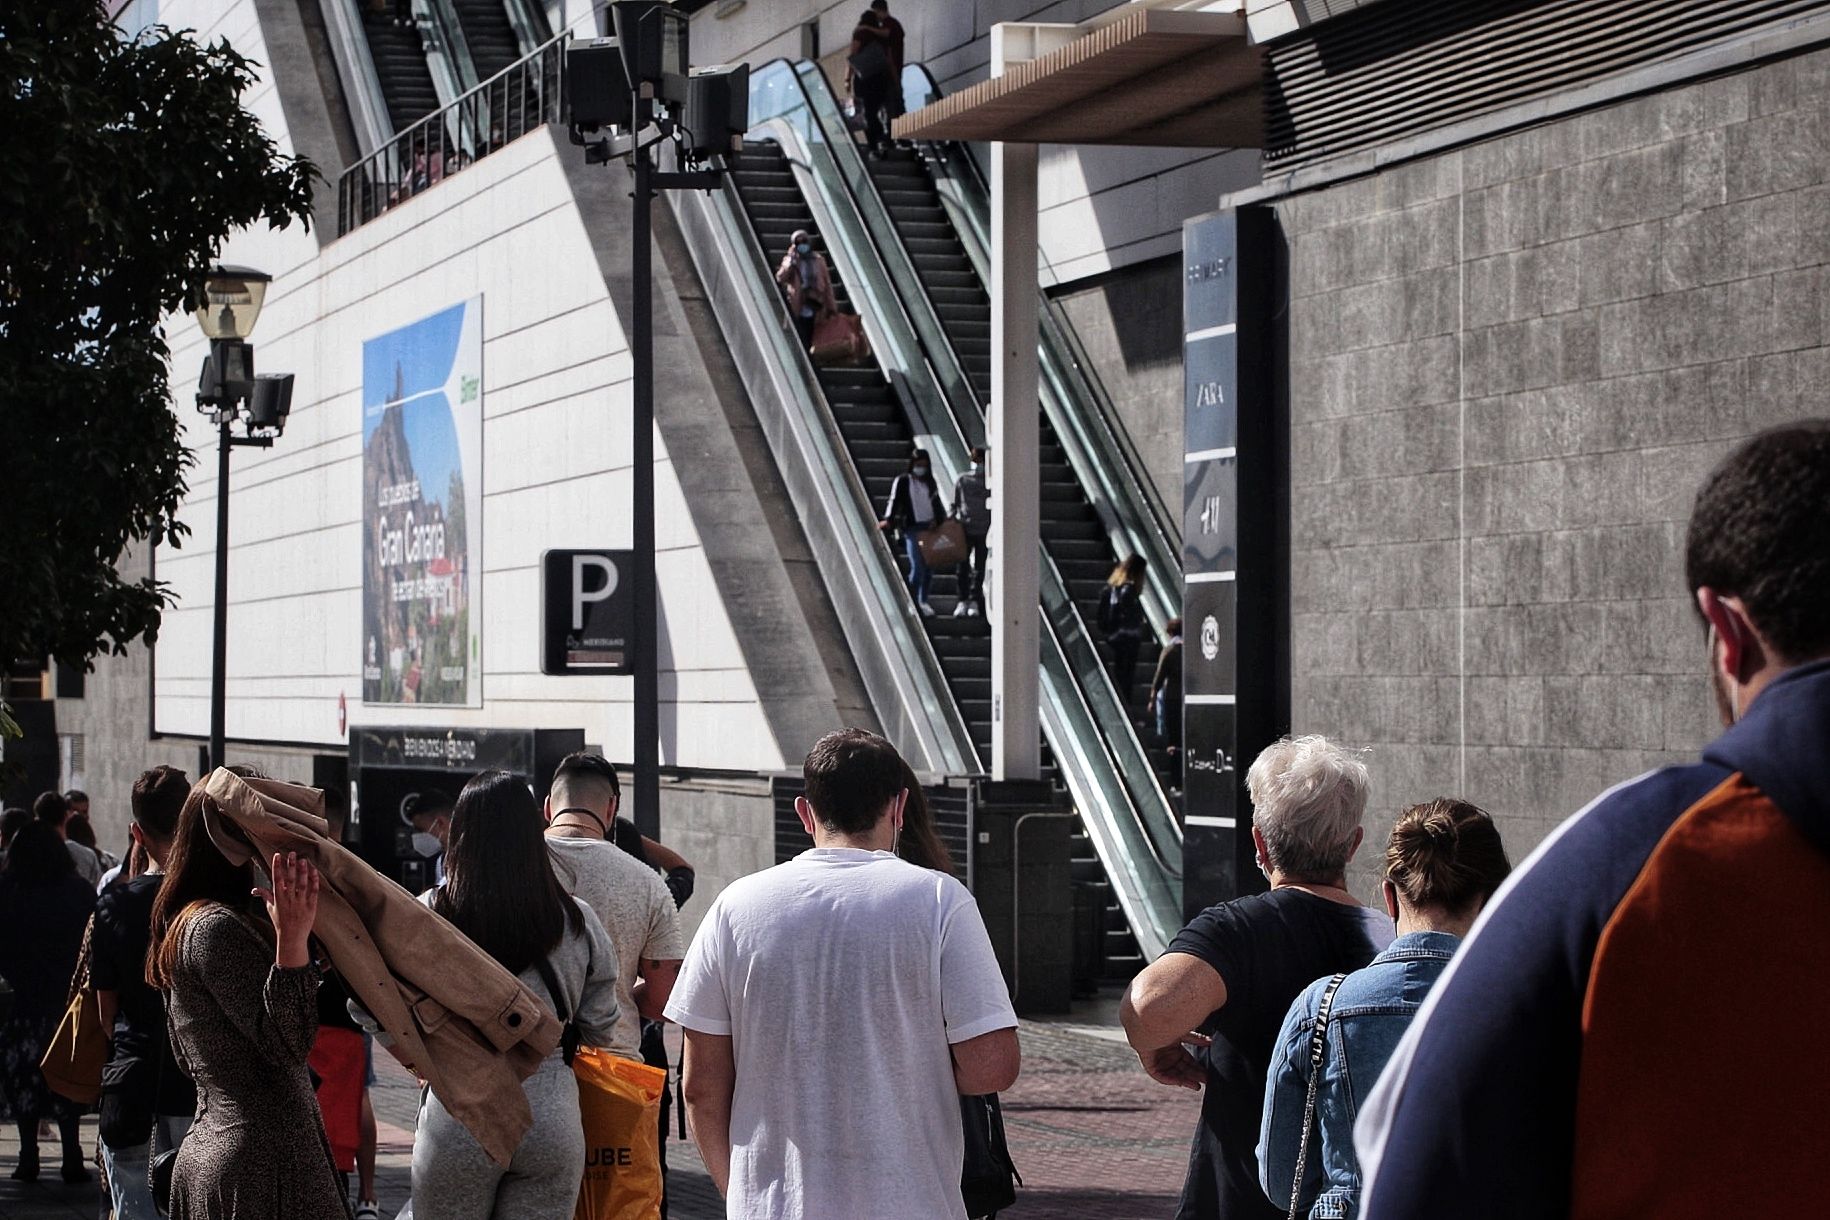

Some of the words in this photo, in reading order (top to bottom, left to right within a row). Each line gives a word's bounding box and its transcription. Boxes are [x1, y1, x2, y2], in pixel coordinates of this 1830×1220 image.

[1197, 382, 1224, 407] ZARA
[379, 516, 404, 567] Gran
[404, 509, 446, 563] Canaria
[572, 554, 619, 630] P
